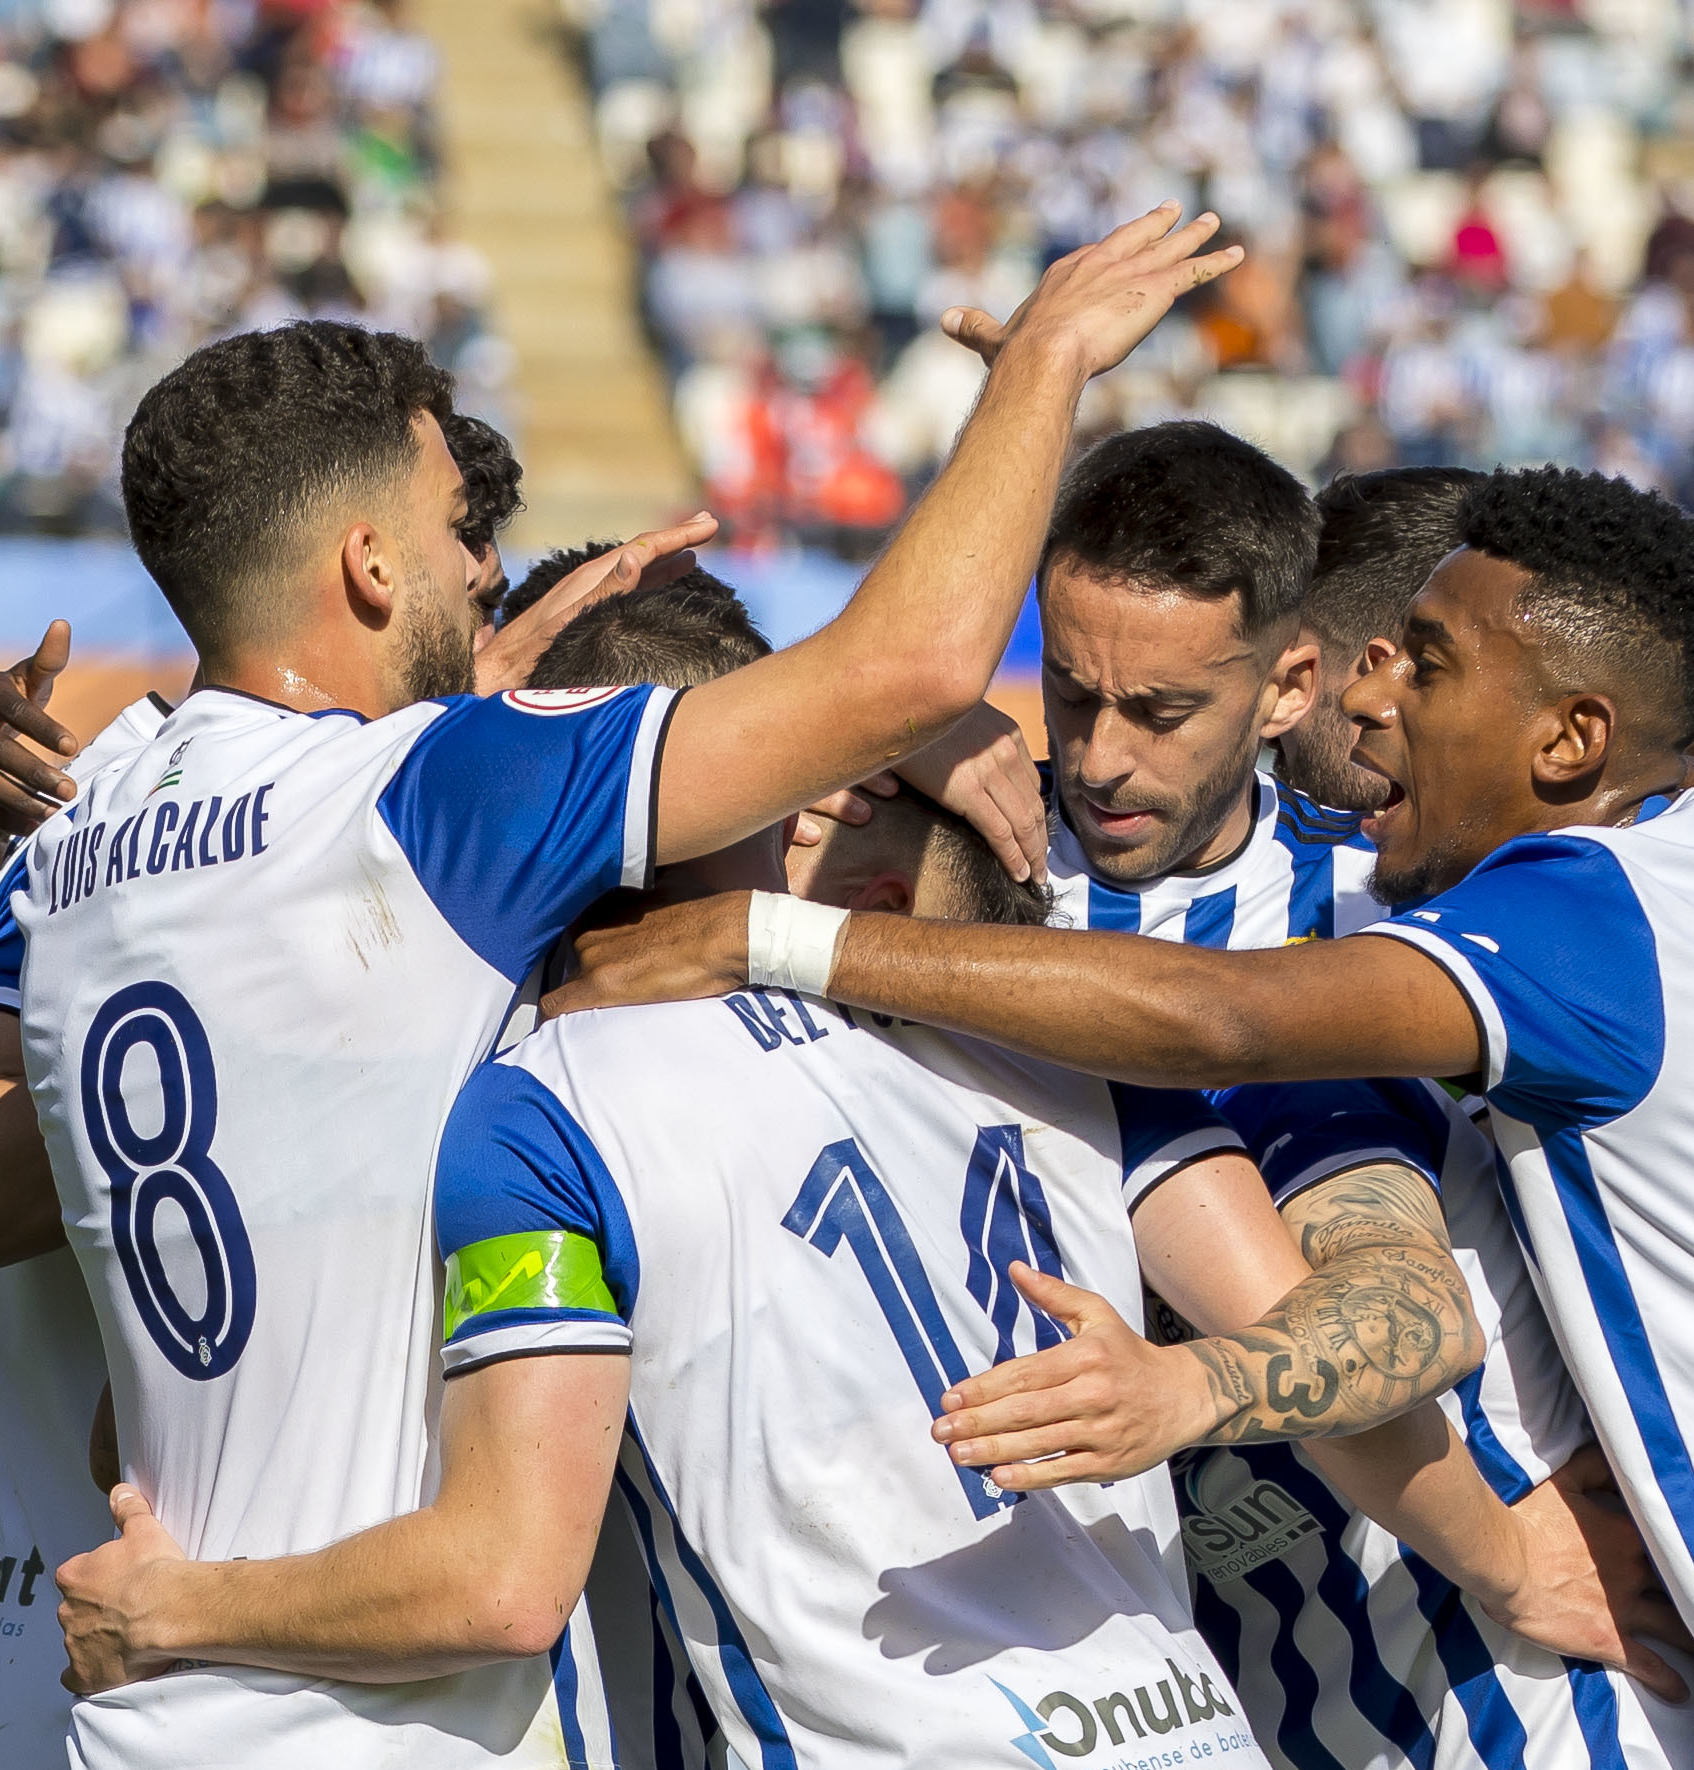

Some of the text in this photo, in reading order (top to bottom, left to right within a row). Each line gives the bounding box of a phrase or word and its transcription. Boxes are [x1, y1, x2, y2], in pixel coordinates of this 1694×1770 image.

[48, 781, 276, 916] LUIS ALCALDE
[81, 979, 257, 1382] 8
[1208, 1536, 1288, 1581] renovables
[1190, 1740, 1213, 1760] de
